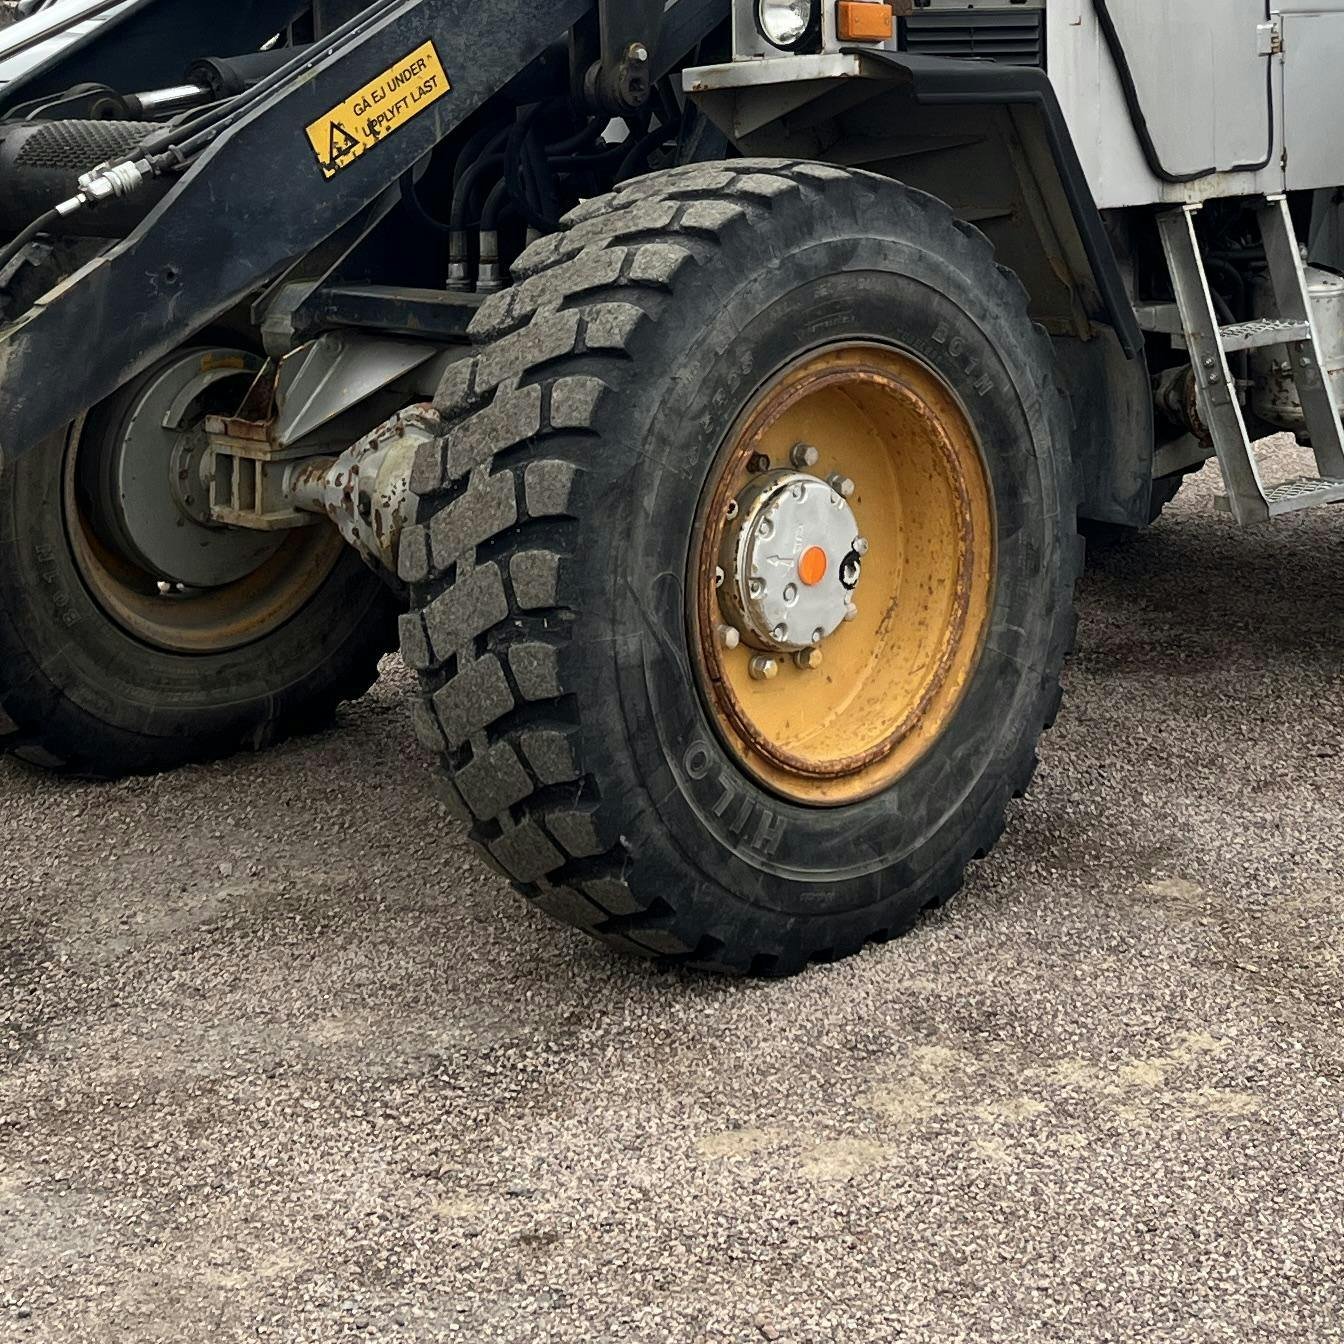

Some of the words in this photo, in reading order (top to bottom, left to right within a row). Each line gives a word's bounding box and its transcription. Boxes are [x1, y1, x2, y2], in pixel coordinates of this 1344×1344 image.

[353, 96, 372, 116] GÅ
[371, 86, 386, 104] EJ
[387, 58, 427, 92] UNDER
[362, 96, 409, 137] UPPLYFT
[410, 75, 438, 104] LAST
[682, 739, 787, 856] HILO
